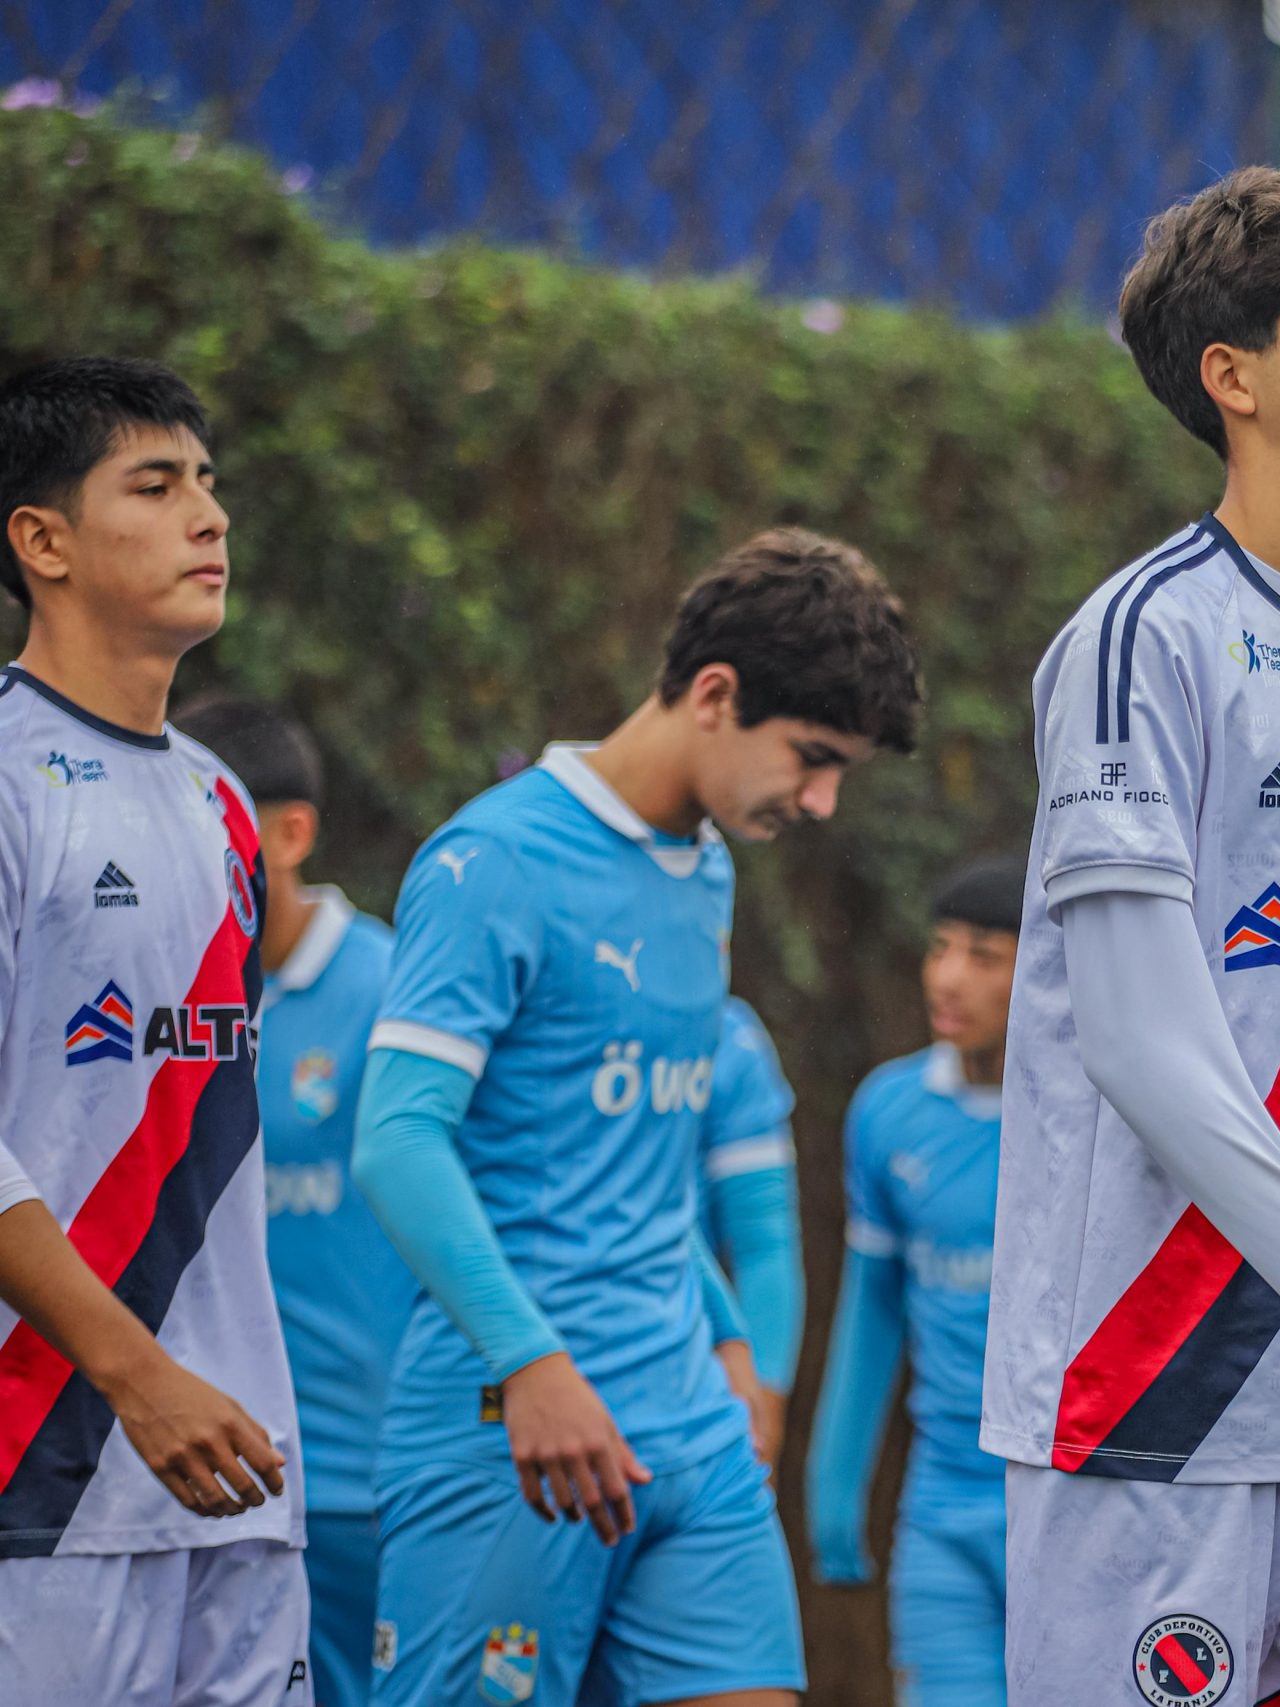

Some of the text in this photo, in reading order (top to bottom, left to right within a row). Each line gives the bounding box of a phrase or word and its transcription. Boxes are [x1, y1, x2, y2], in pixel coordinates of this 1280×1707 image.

[1049, 790, 1114, 812] ADRIANO
[1141, 1621, 1224, 1655] CLUB DEPORTIVO
[1150, 1689, 1164, 1703] LA
